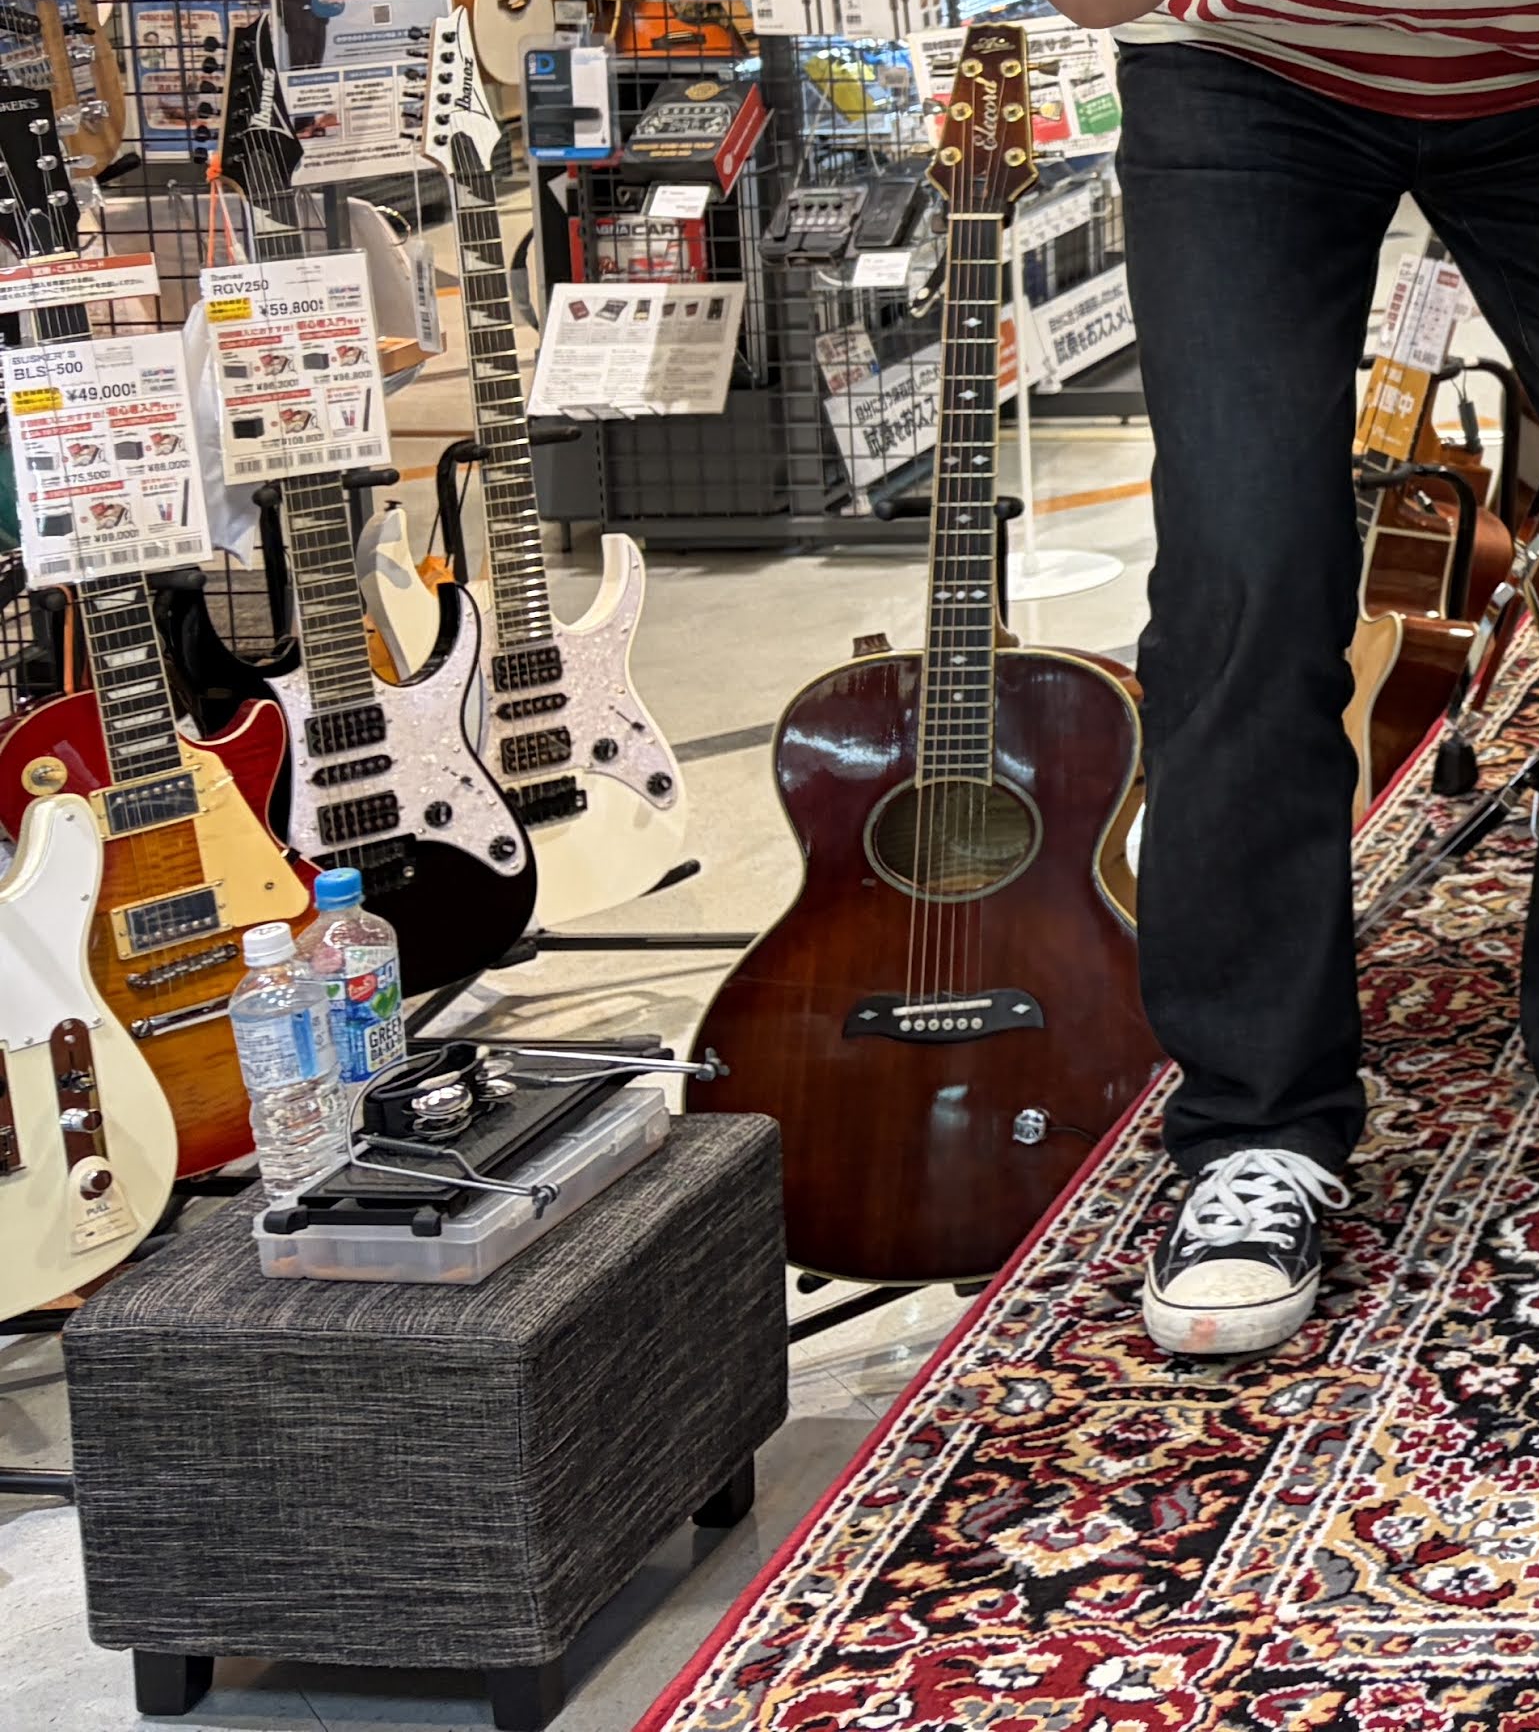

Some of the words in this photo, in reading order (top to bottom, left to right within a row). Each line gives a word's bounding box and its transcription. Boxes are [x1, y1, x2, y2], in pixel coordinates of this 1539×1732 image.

[454, 56, 474, 112] Ibanez
[213, 280, 269, 295] RGV250
[14, 361, 83, 380] BLS-500
[67, 383, 131, 402] ¥49,000
